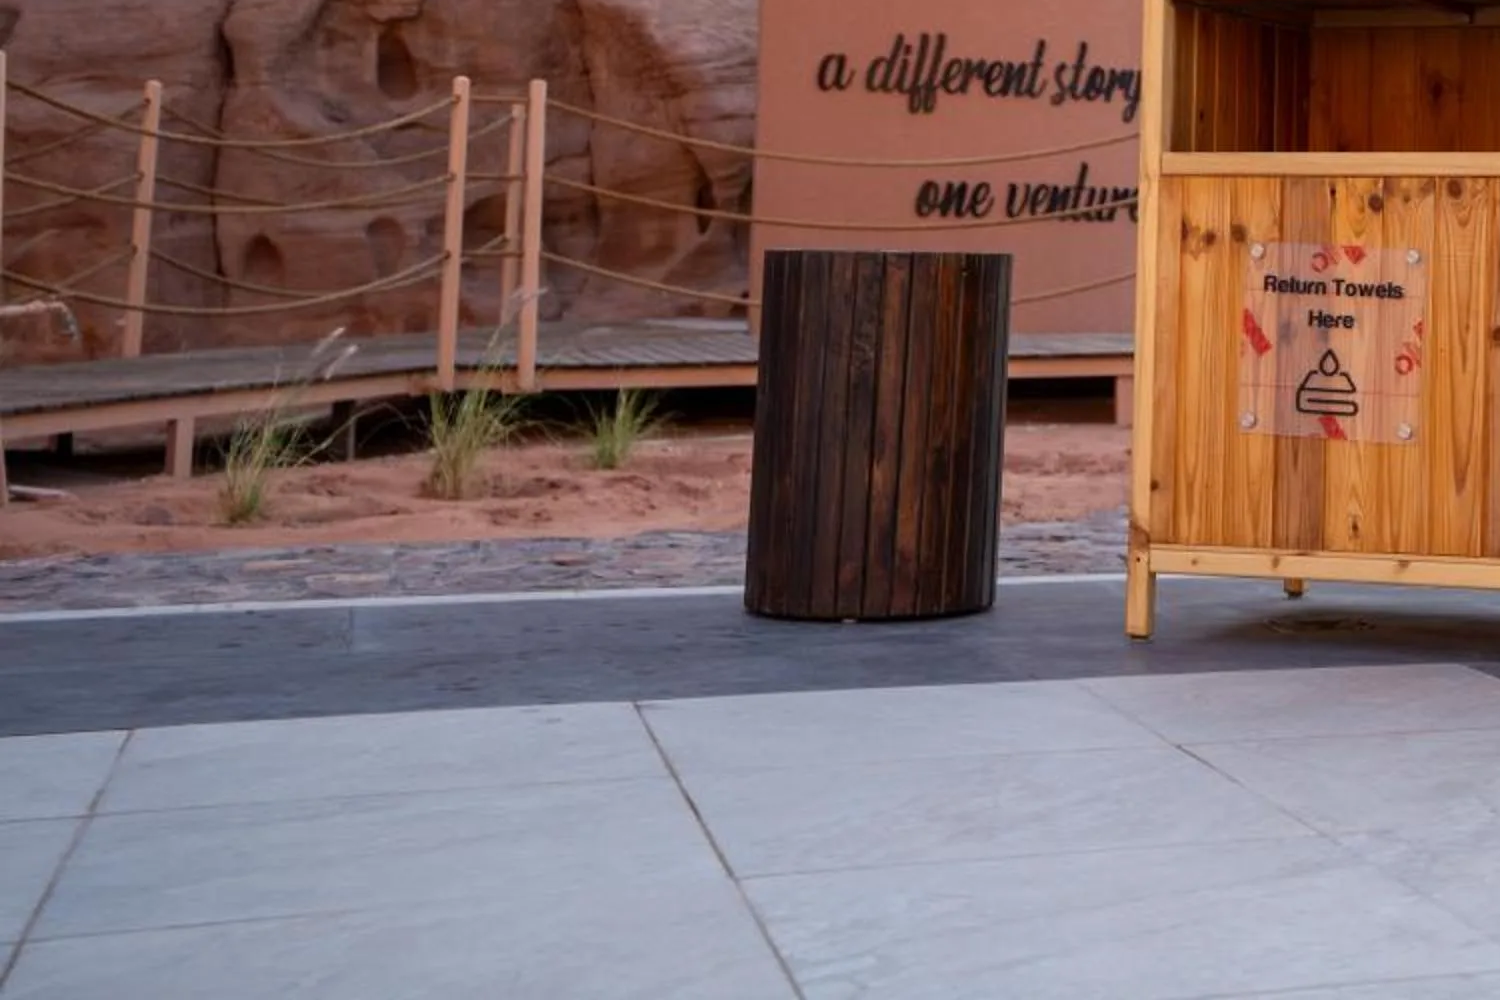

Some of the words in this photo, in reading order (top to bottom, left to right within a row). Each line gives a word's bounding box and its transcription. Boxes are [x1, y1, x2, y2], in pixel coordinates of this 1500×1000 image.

[817, 53, 855, 91] a
[865, 33, 1048, 114] different
[1049, 41, 1142, 123] story
[914, 179, 994, 219] one
[1263, 275, 1327, 295] Return
[1331, 278, 1404, 299] Towels
[1307, 309, 1355, 329] Here
